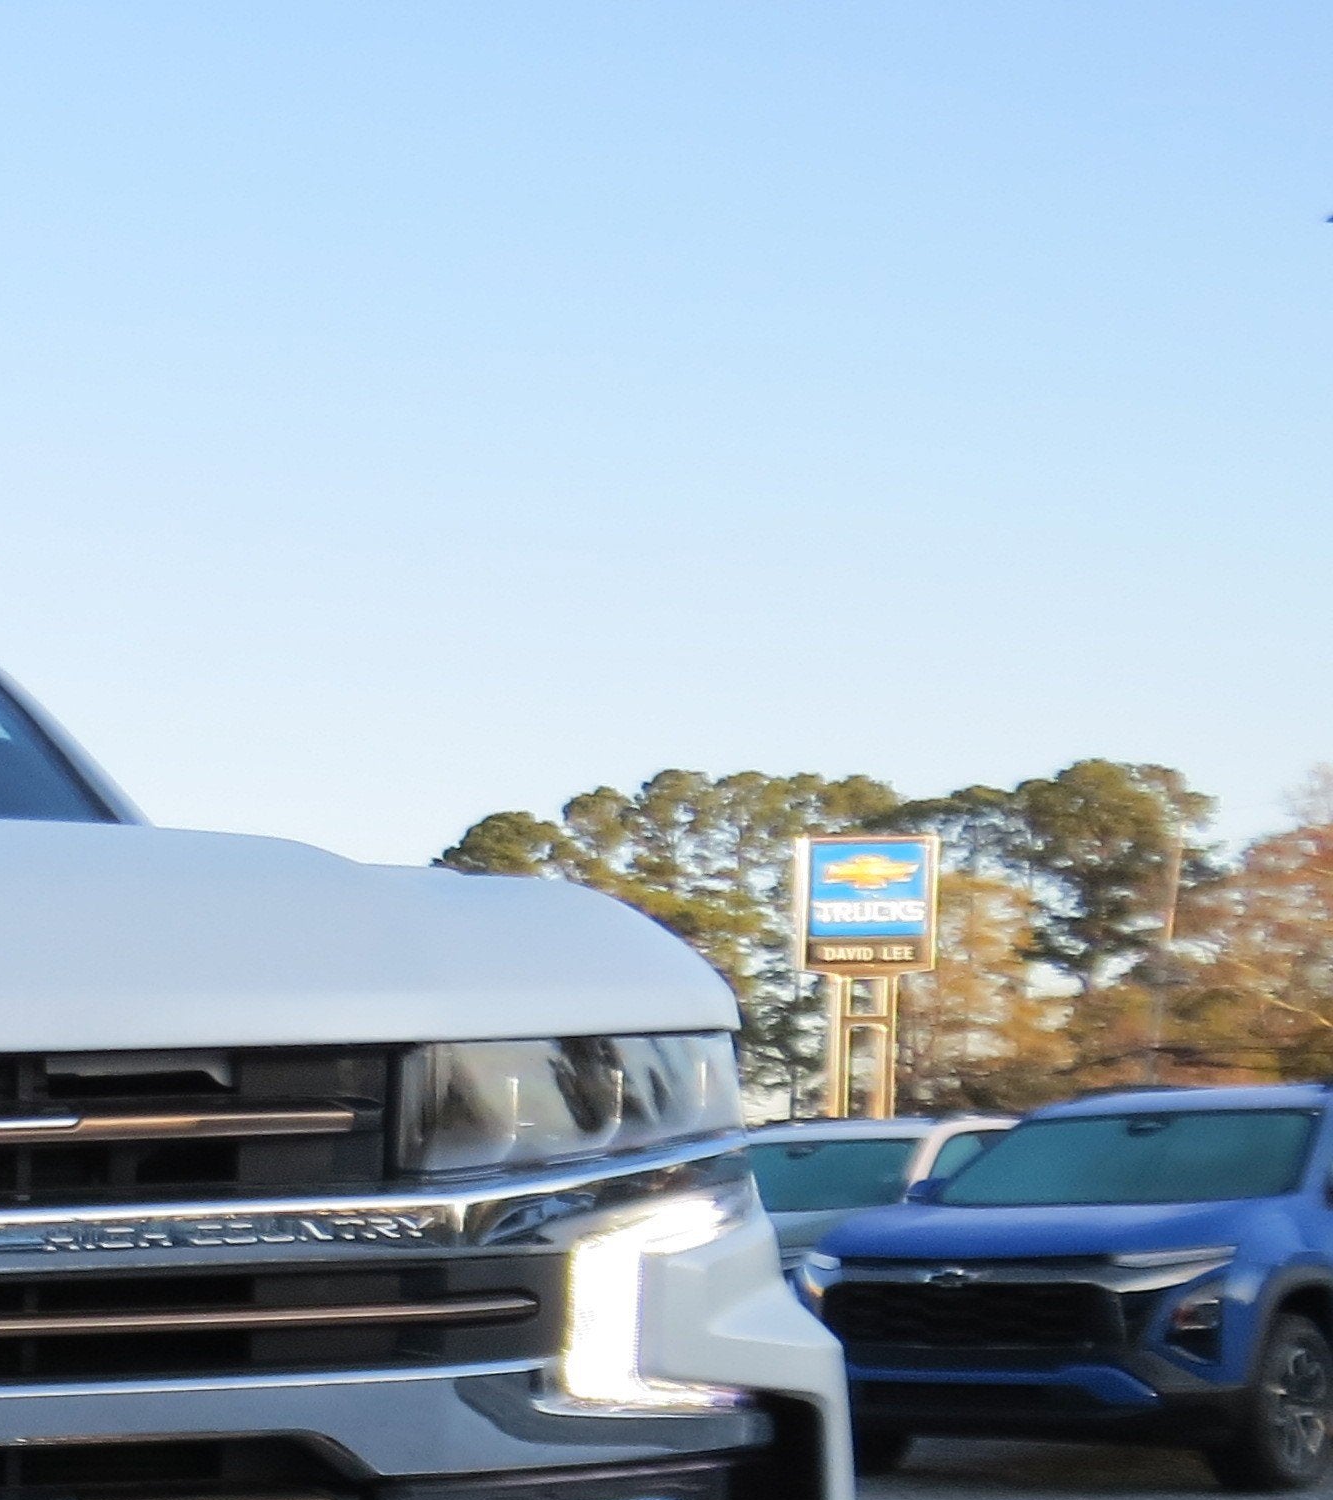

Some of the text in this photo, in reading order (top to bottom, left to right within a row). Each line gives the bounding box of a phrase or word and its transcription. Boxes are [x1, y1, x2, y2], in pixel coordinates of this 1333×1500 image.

[812, 900, 927, 923] TRUCKS
[823, 945, 916, 962] DAVID LEE
